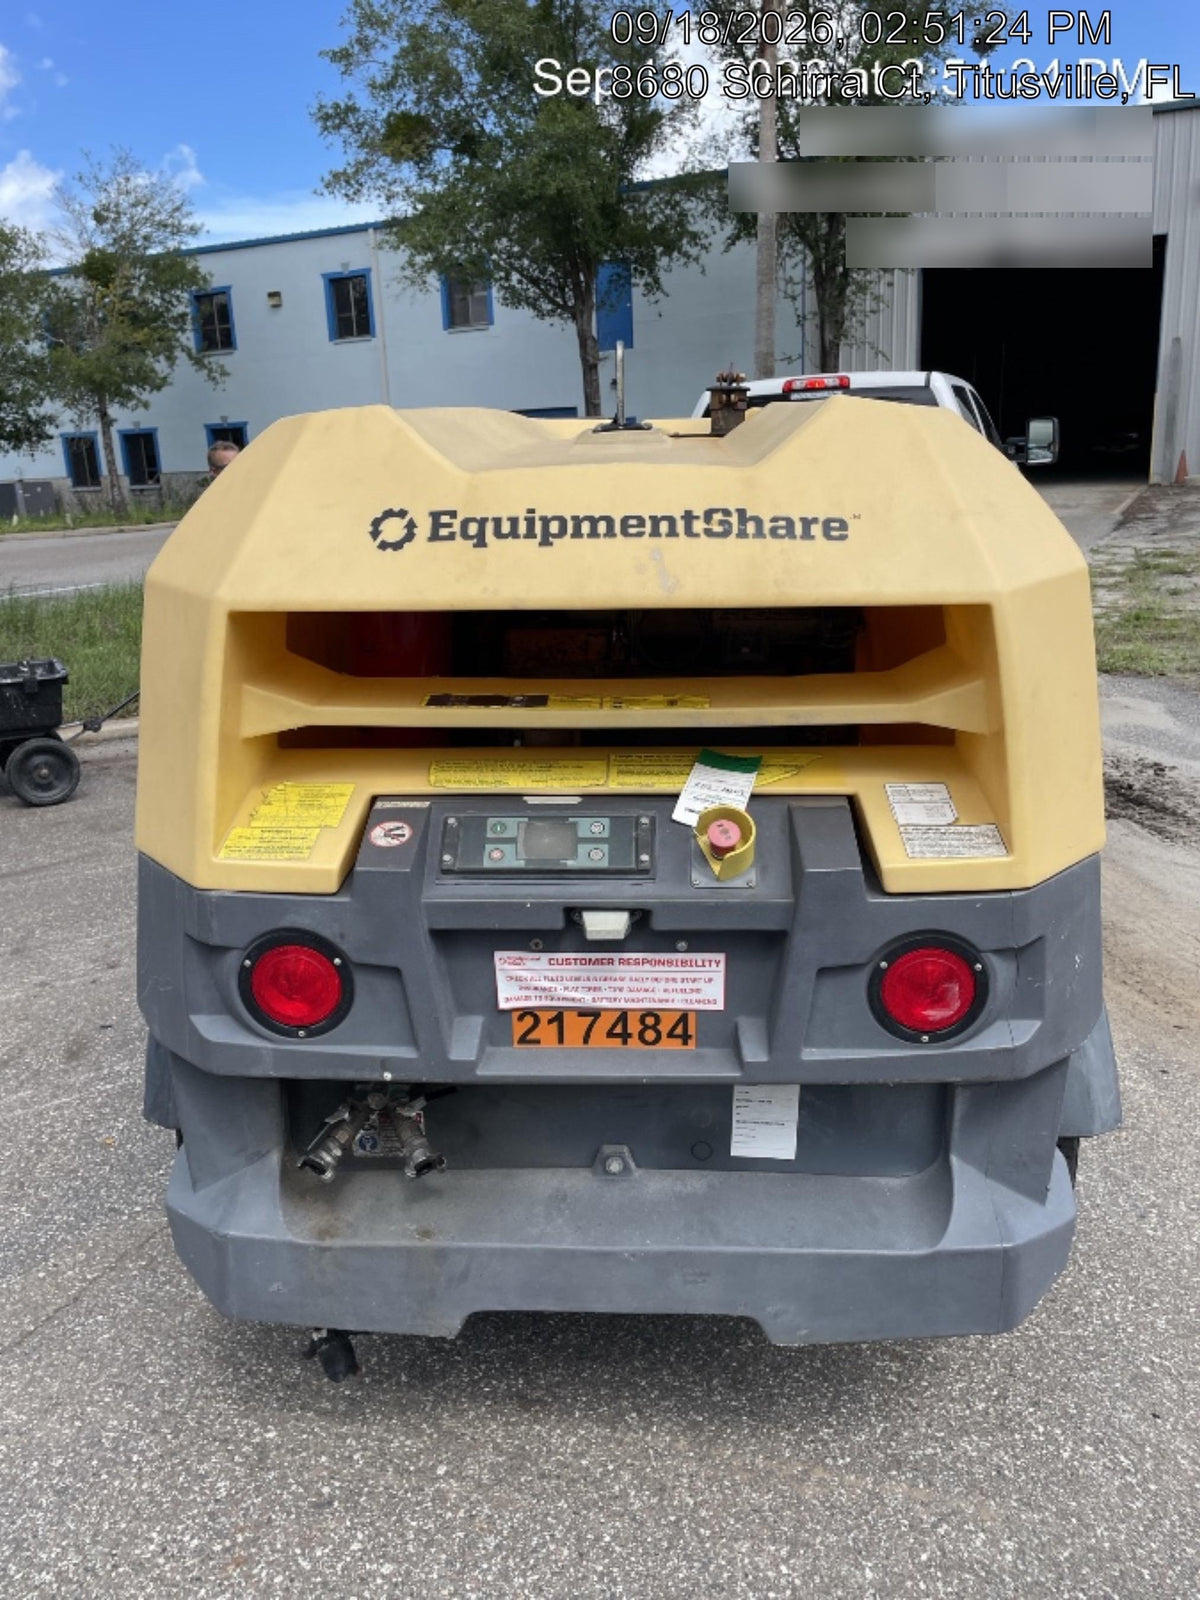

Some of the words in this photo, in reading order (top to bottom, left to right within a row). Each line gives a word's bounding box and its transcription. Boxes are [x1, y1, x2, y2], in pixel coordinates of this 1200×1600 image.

[427, 507, 849, 548] EquipmentShare
[547, 956, 614, 967] CUSTOMER
[618, 957, 722, 969] RESPONSIBILITY
[516, 1011, 693, 1047] 217484
